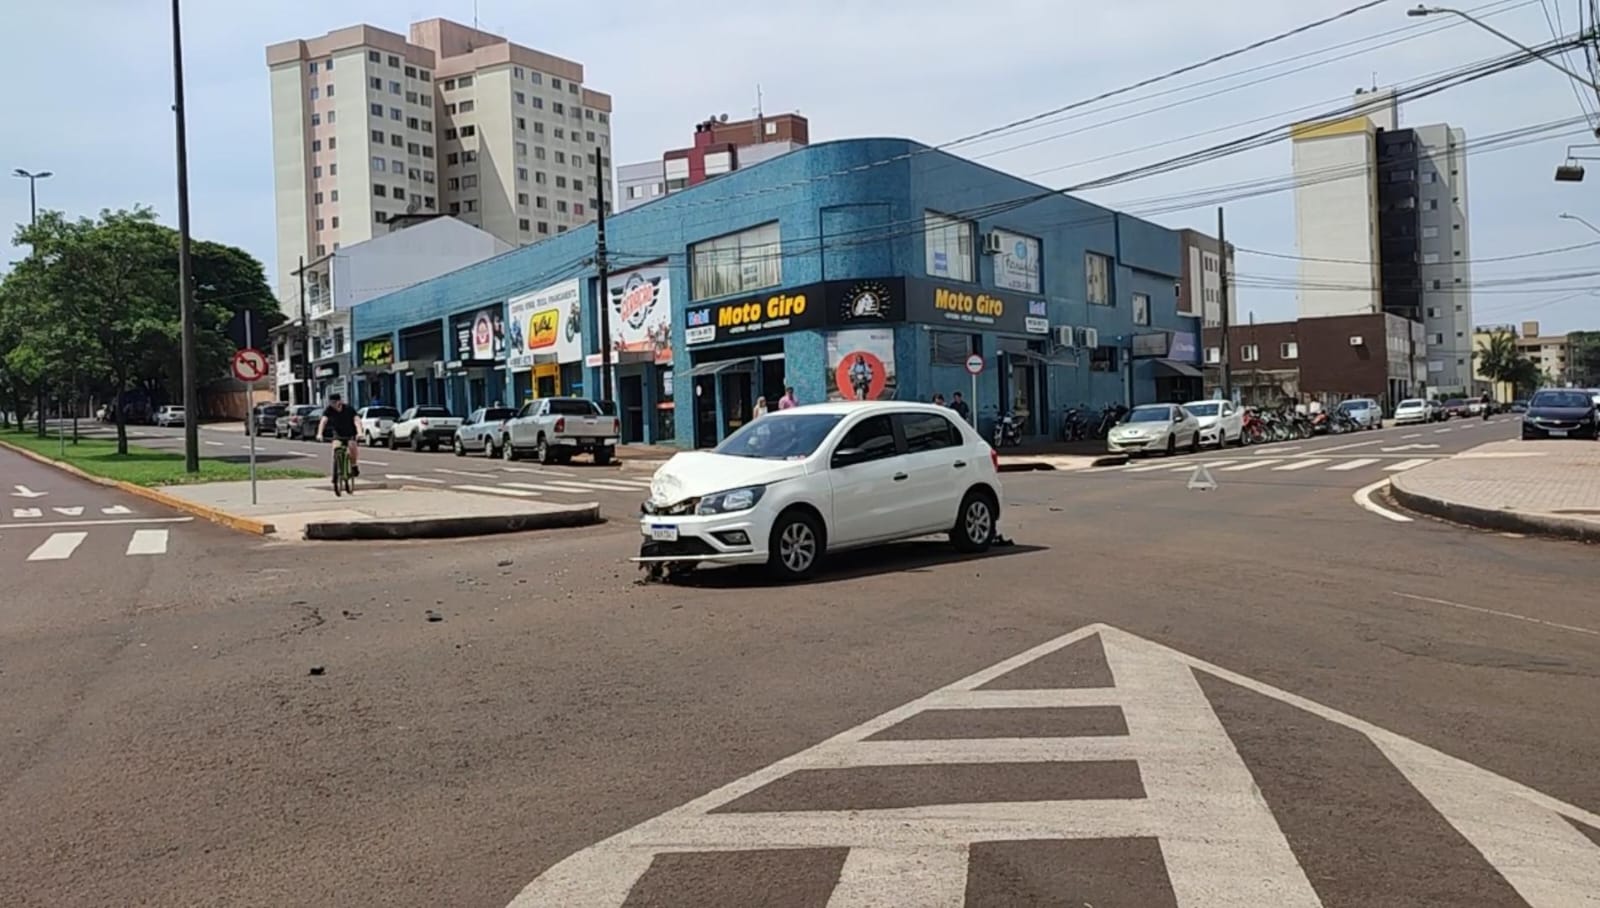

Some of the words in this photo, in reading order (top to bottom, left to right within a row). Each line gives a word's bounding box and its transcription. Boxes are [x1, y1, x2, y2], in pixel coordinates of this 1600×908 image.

[718, 303, 762, 327] Moto
[767, 294, 806, 318] Giro
[935, 288, 973, 313] Moto
[976, 293, 1003, 317] Giro
